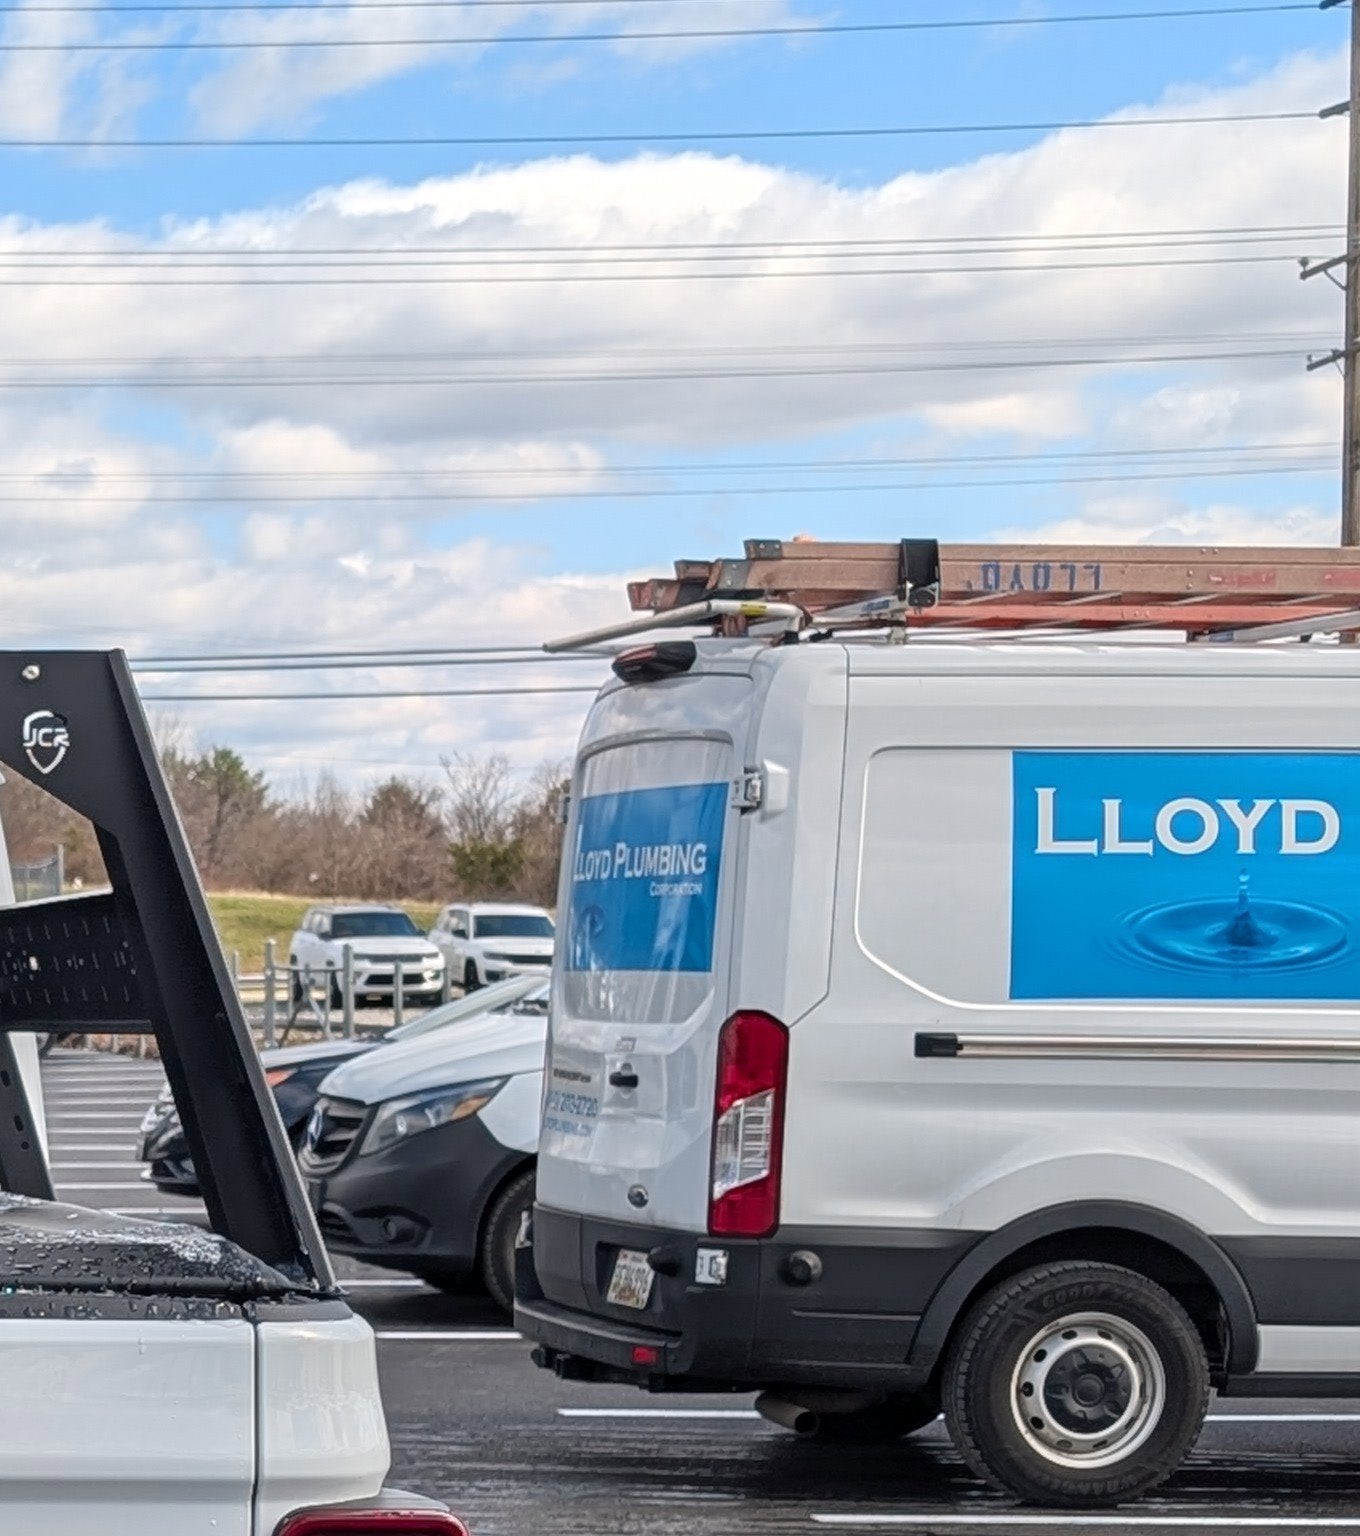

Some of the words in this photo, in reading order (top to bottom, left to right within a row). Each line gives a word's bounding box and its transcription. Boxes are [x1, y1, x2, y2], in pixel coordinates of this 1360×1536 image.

[981, 561, 1103, 592] LLOYD
[1033, 787, 1340, 857] LLOYD
[573, 825, 612, 881] LLOYD
[613, 842, 708, 879] PLUMBING
